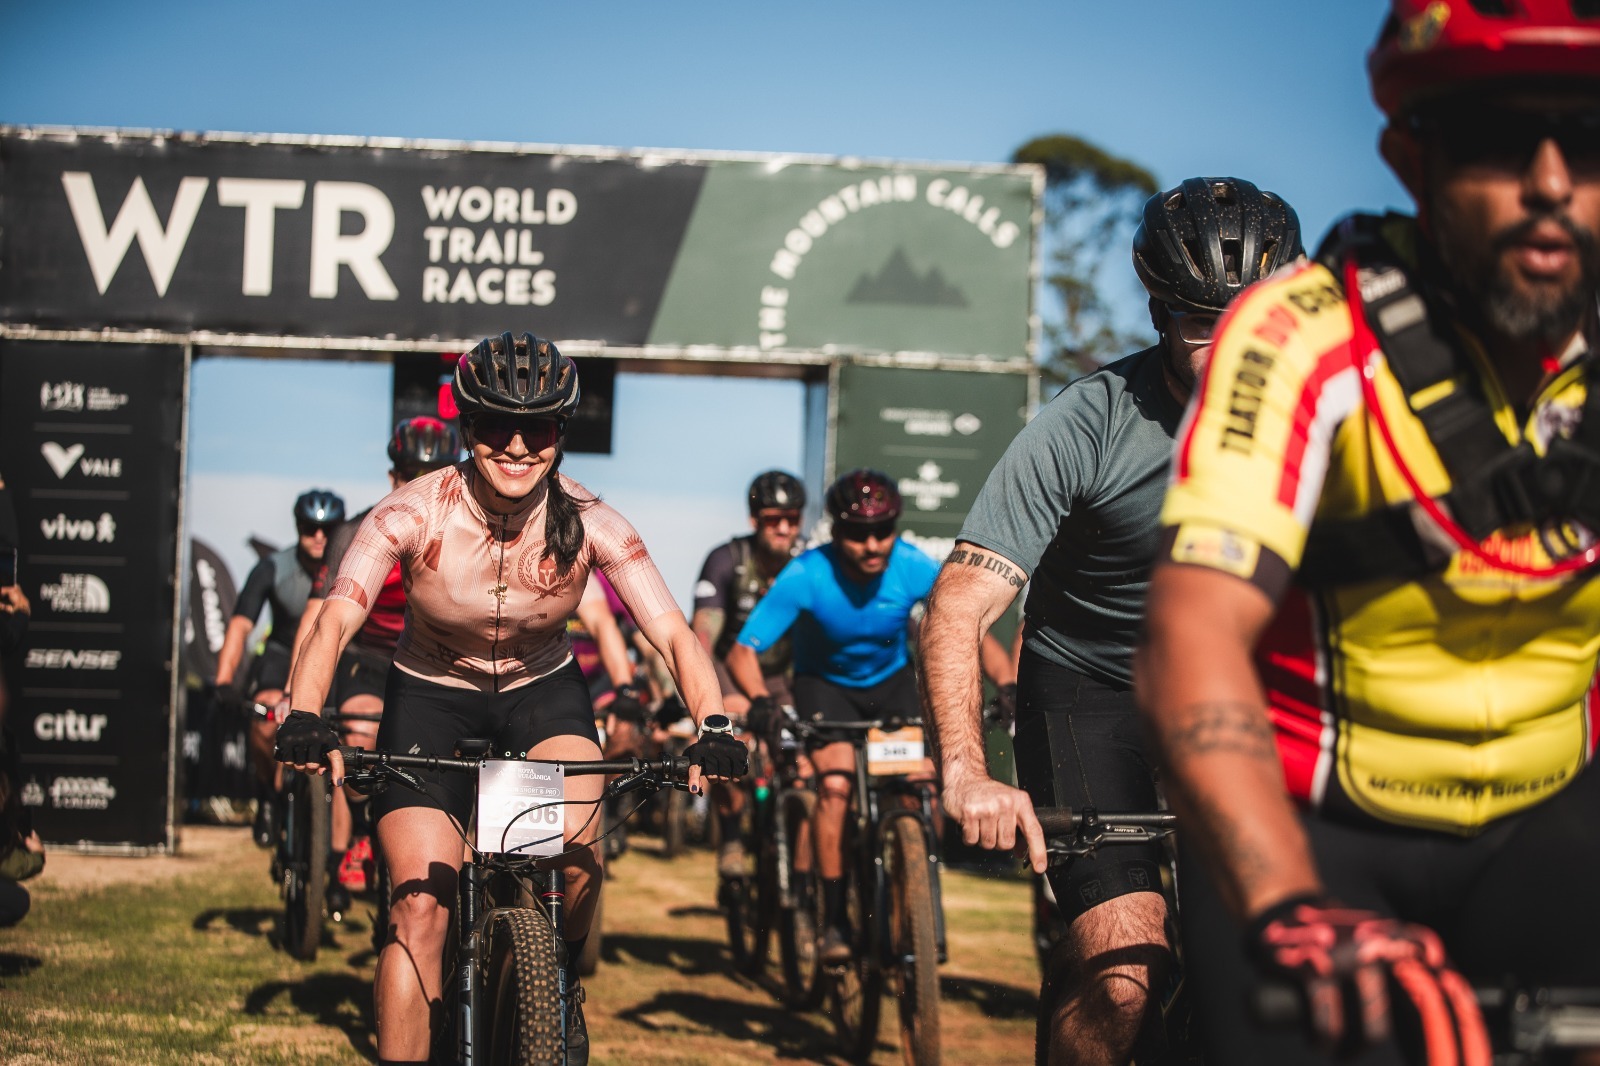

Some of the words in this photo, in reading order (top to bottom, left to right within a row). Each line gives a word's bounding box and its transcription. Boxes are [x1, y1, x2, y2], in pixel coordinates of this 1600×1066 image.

[421, 185, 578, 226] WORLD
[926, 178, 1021, 249] CALLS
[61, 171, 398, 301] WTR
[423, 227, 544, 266] TRAIL
[769, 174, 918, 280] MOUNTAIN
[422, 267, 556, 306] RACES
[758, 286, 789, 349] THE
[81, 457, 122, 477] VALE
[41, 513, 95, 541] vivo
[967, 552, 985, 566] TO
[984, 557, 1013, 580] LIVE
[24, 648, 121, 670] SENSE
